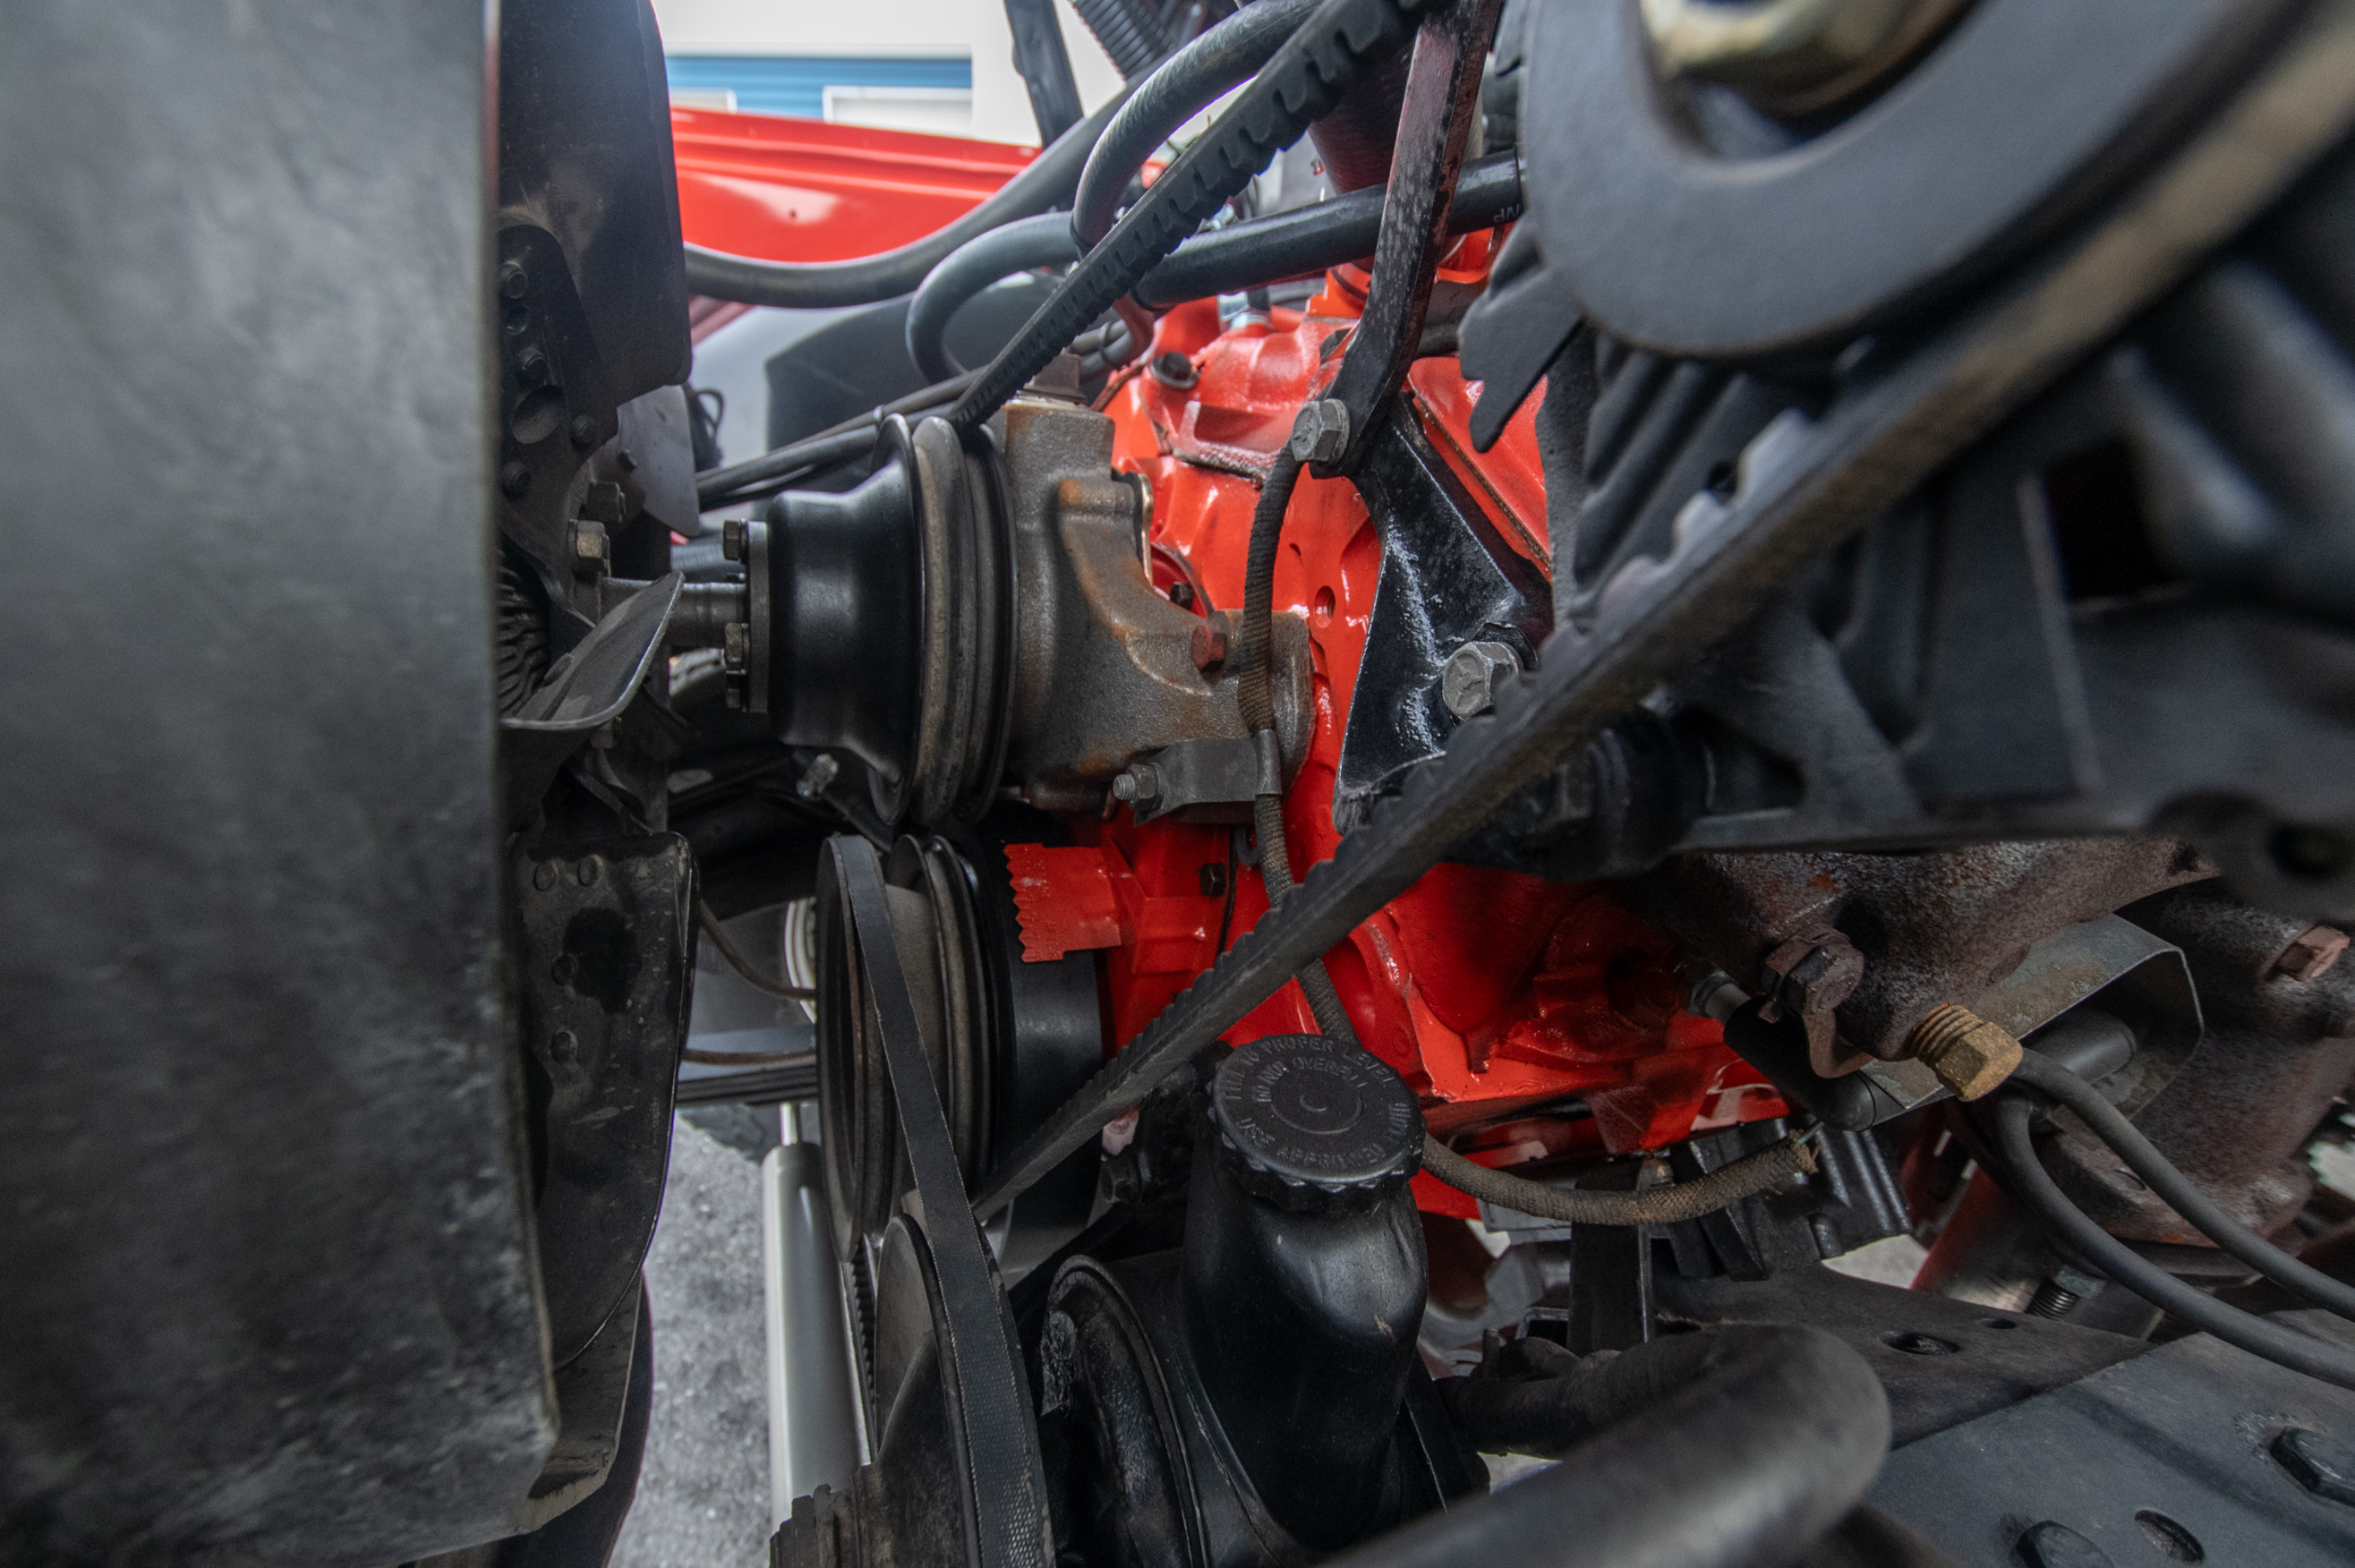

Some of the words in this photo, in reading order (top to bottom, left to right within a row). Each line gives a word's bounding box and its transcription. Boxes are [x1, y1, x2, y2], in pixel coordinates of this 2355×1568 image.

[1223, 1069, 1245, 1100] FILL
[1238, 1050, 1259, 1066] TO
[1259, 1035, 1334, 1054] PROPER
[1343, 1045, 1395, 1088] LEVEL
[1255, 1084, 1272, 1103] DO
[1235, 1117, 1276, 1148] USE
[1276, 1143, 1387, 1169] APPROVED
